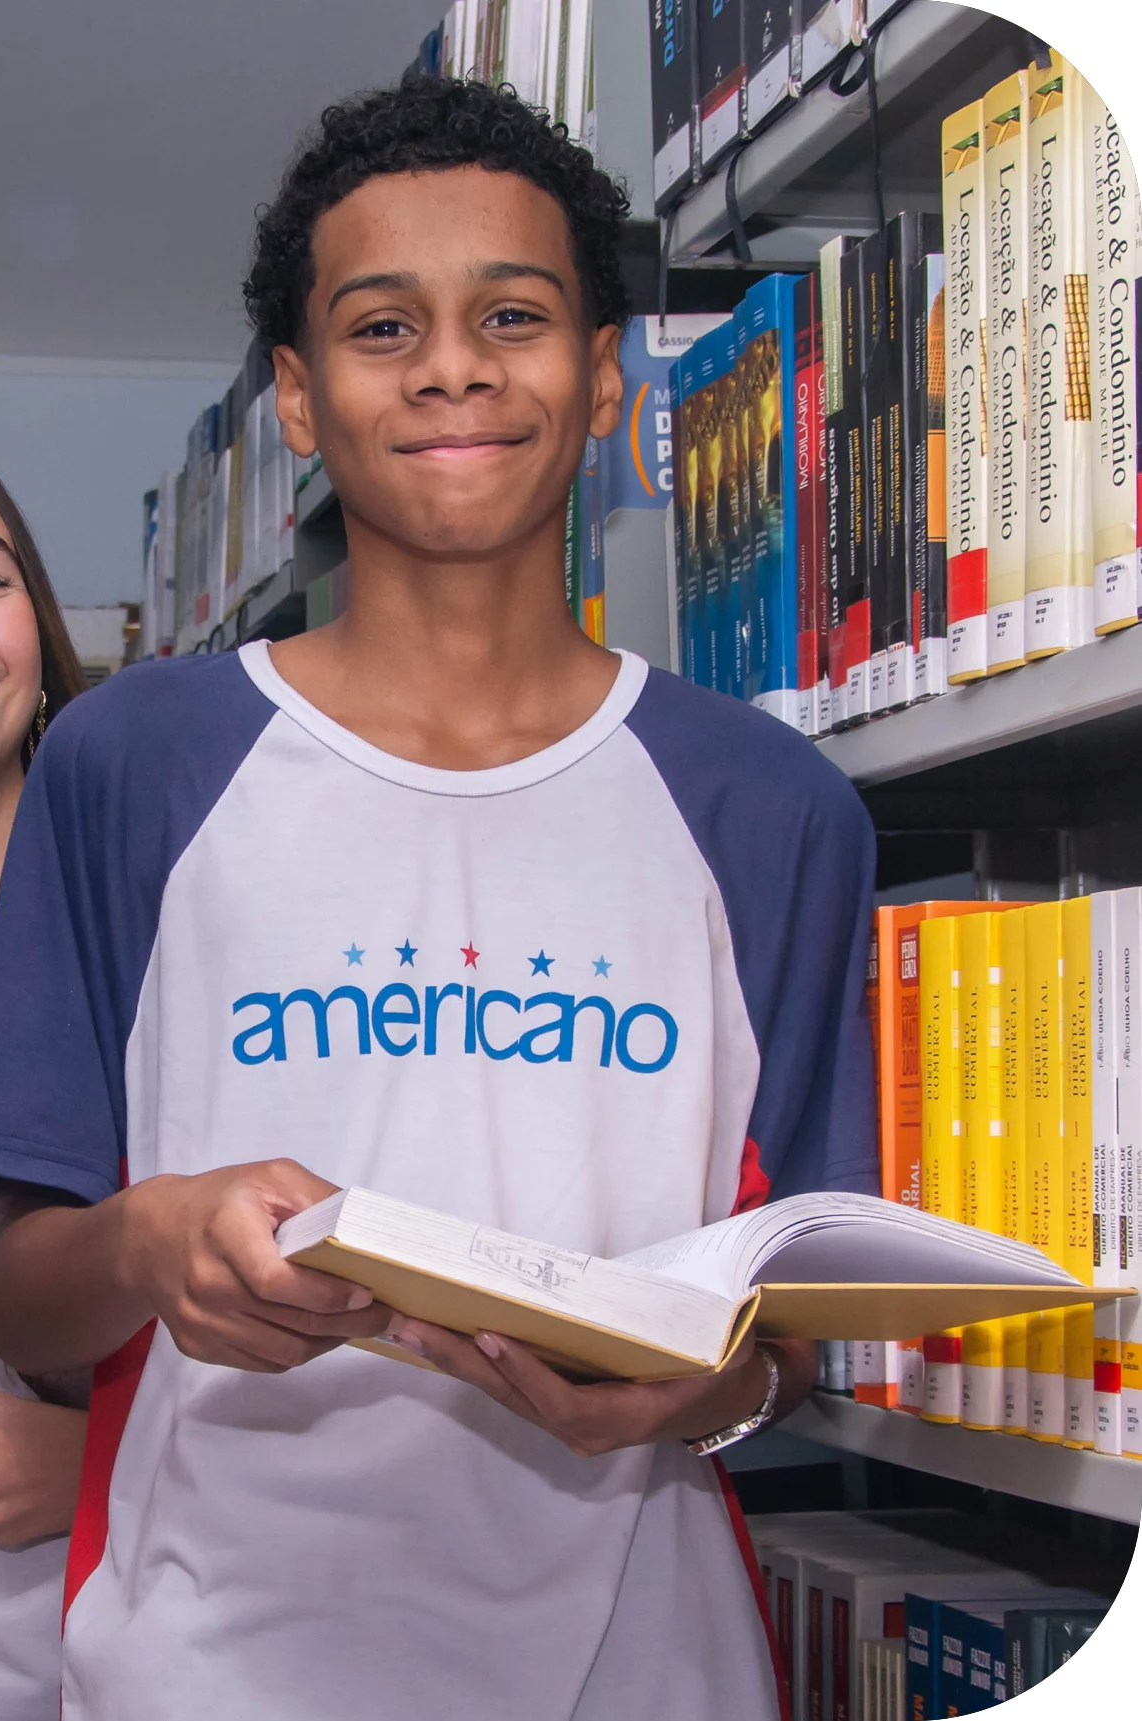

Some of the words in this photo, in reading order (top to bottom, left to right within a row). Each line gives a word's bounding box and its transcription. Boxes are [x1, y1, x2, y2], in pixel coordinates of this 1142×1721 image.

[1039, 133, 1057, 272] Locação
[1093, 124, 1105, 241] ADALBERTO
[1103, 105, 1126, 225] ocação
[957, 185, 975, 316] Locação
[998, 160, 1016, 296] Locação
[1096, 250, 1106, 275] DE
[1108, 238, 1128, 269] &
[960, 327, 975, 355] &
[992, 318, 999, 341] DE
[1001, 307, 1017, 336] &
[1032, 294, 1039, 318] DE
[1040, 283, 1058, 314] &
[1097, 284, 1107, 378] ANDRADE
[951, 338, 958, 360] DE
[1030, 327, 1038, 418] ANDRADE
[1109, 278, 1131, 487] Condomínio
[992, 350, 1000, 438] ANDRADE
[1038, 323, 1057, 524] Condomínio
[1100, 388, 1108, 465] MACIEL
[959, 365, 976, 553] Condomínio
[992, 446, 1000, 518] MACIEL
[1001, 345, 1018, 540] Condomínio
[1030, 427, 1038, 500] MACIEL
[828, 428, 839, 549] Obrigações
[830, 555, 838, 590] das
[232, 982, 679, 1074] americano
[933, 990, 941, 1100] COMERCIAL
[1079, 975, 1087, 1097] COMERCIAL
[970, 1160, 978, 1228] equião
[1094, 1146, 1099, 1160] DE
[1120, 1147, 1126, 1161] DE
[1041, 1161, 1050, 1246] Requião
[1078, 1161, 1087, 1248] Requião
[1111, 1195, 1116, 1210] DE
